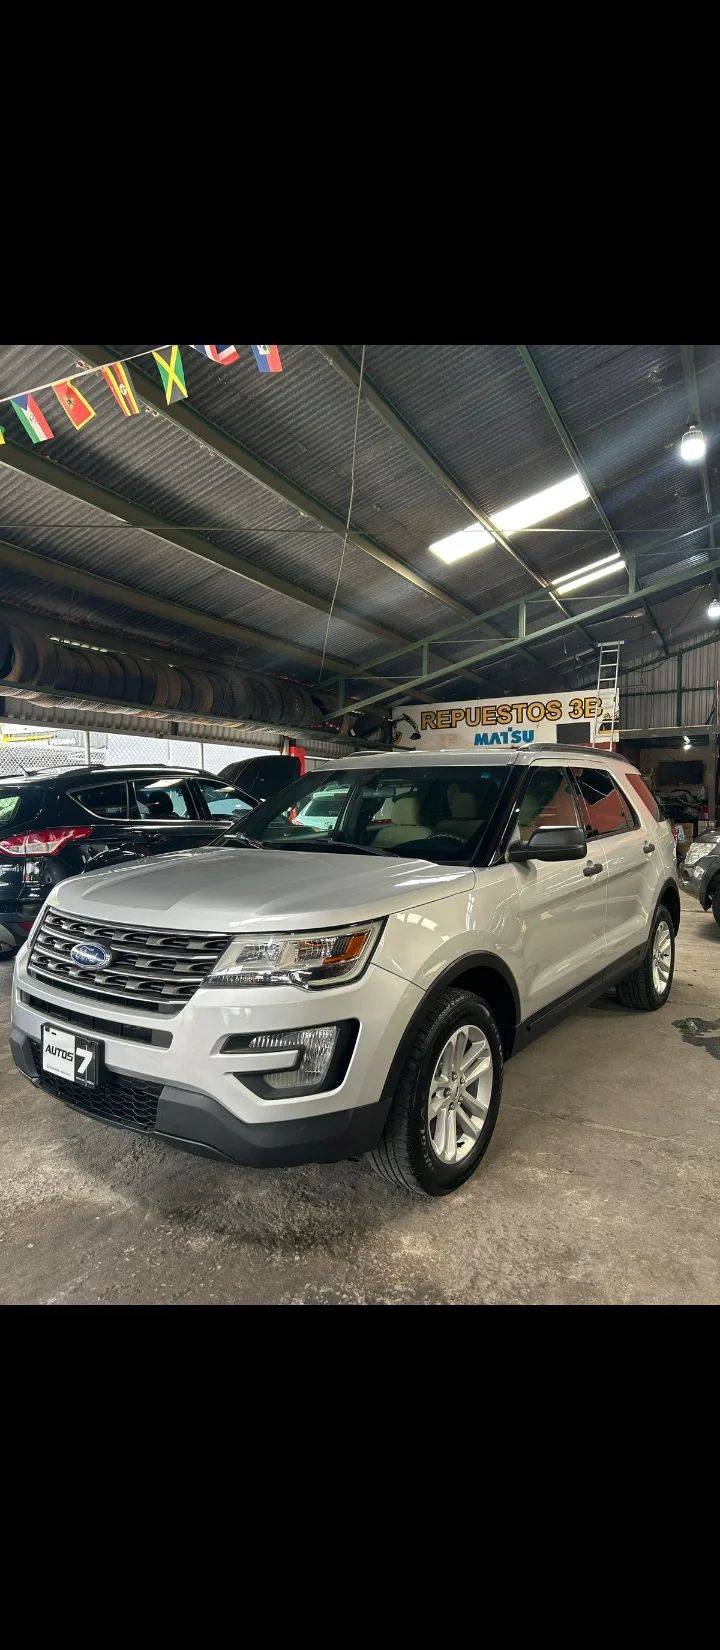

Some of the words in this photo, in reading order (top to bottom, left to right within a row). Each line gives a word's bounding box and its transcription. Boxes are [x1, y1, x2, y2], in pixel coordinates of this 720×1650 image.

[421, 700, 562, 730] REPUESTOS
[568, 697, 603, 719] 3B
[75, 945, 104, 962] Ford
[45, 1044, 74, 1062] AUTOS
[76, 1047, 93, 1074] 7
